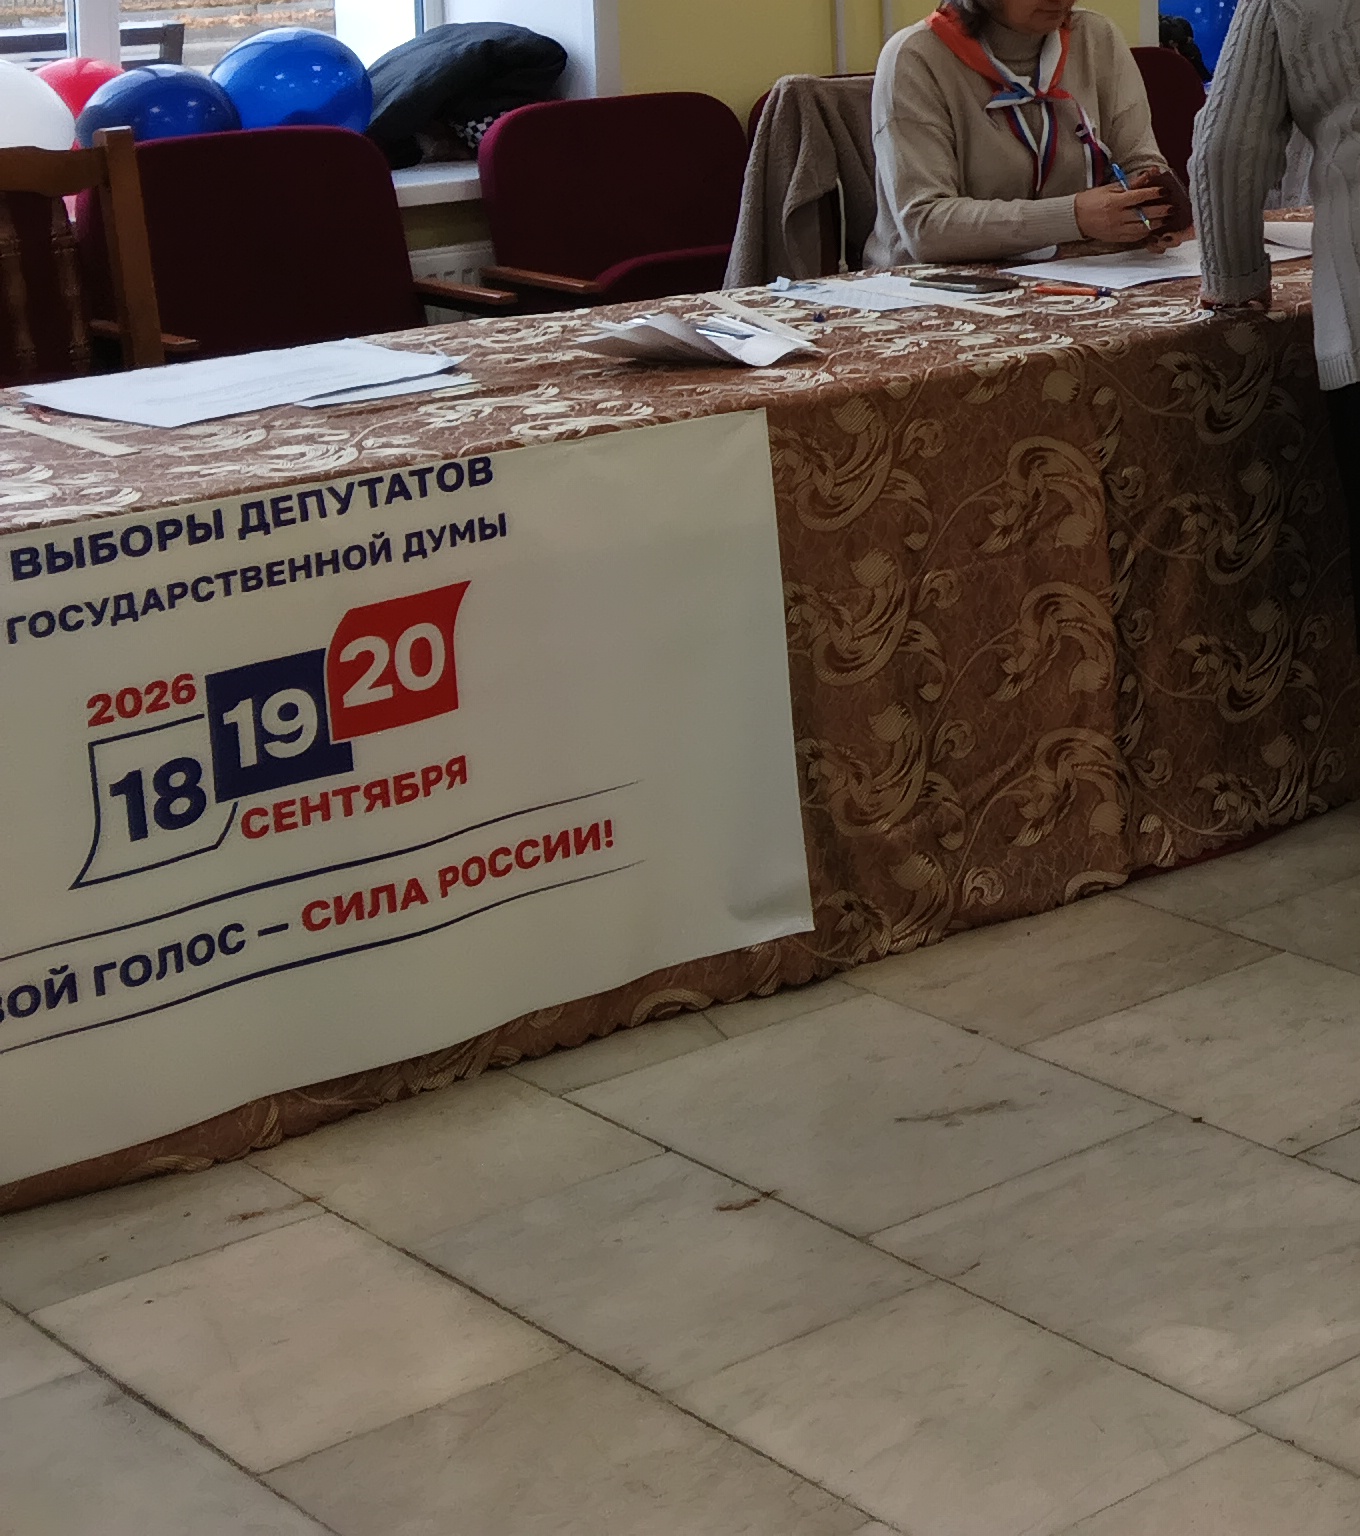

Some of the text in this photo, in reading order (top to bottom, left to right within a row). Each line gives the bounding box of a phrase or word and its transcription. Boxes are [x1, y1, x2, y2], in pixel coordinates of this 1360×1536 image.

[5, 512, 509, 645] ГОСУДАРСТВЕННОЙ ДУМЫ
[10, 455, 494, 581] ВЫБОРЫ ДЕПУТАТОВ
[87, 673, 197, 727] 2026
[109, 621, 447, 842] 18 19 20
[240, 754, 470, 840] СЕНТЯБРЯ
[94, 922, 248, 997] ГОЛОС
[301, 876, 429, 933] СИЛА
[439, 819, 617, 899] РОССИИ!
